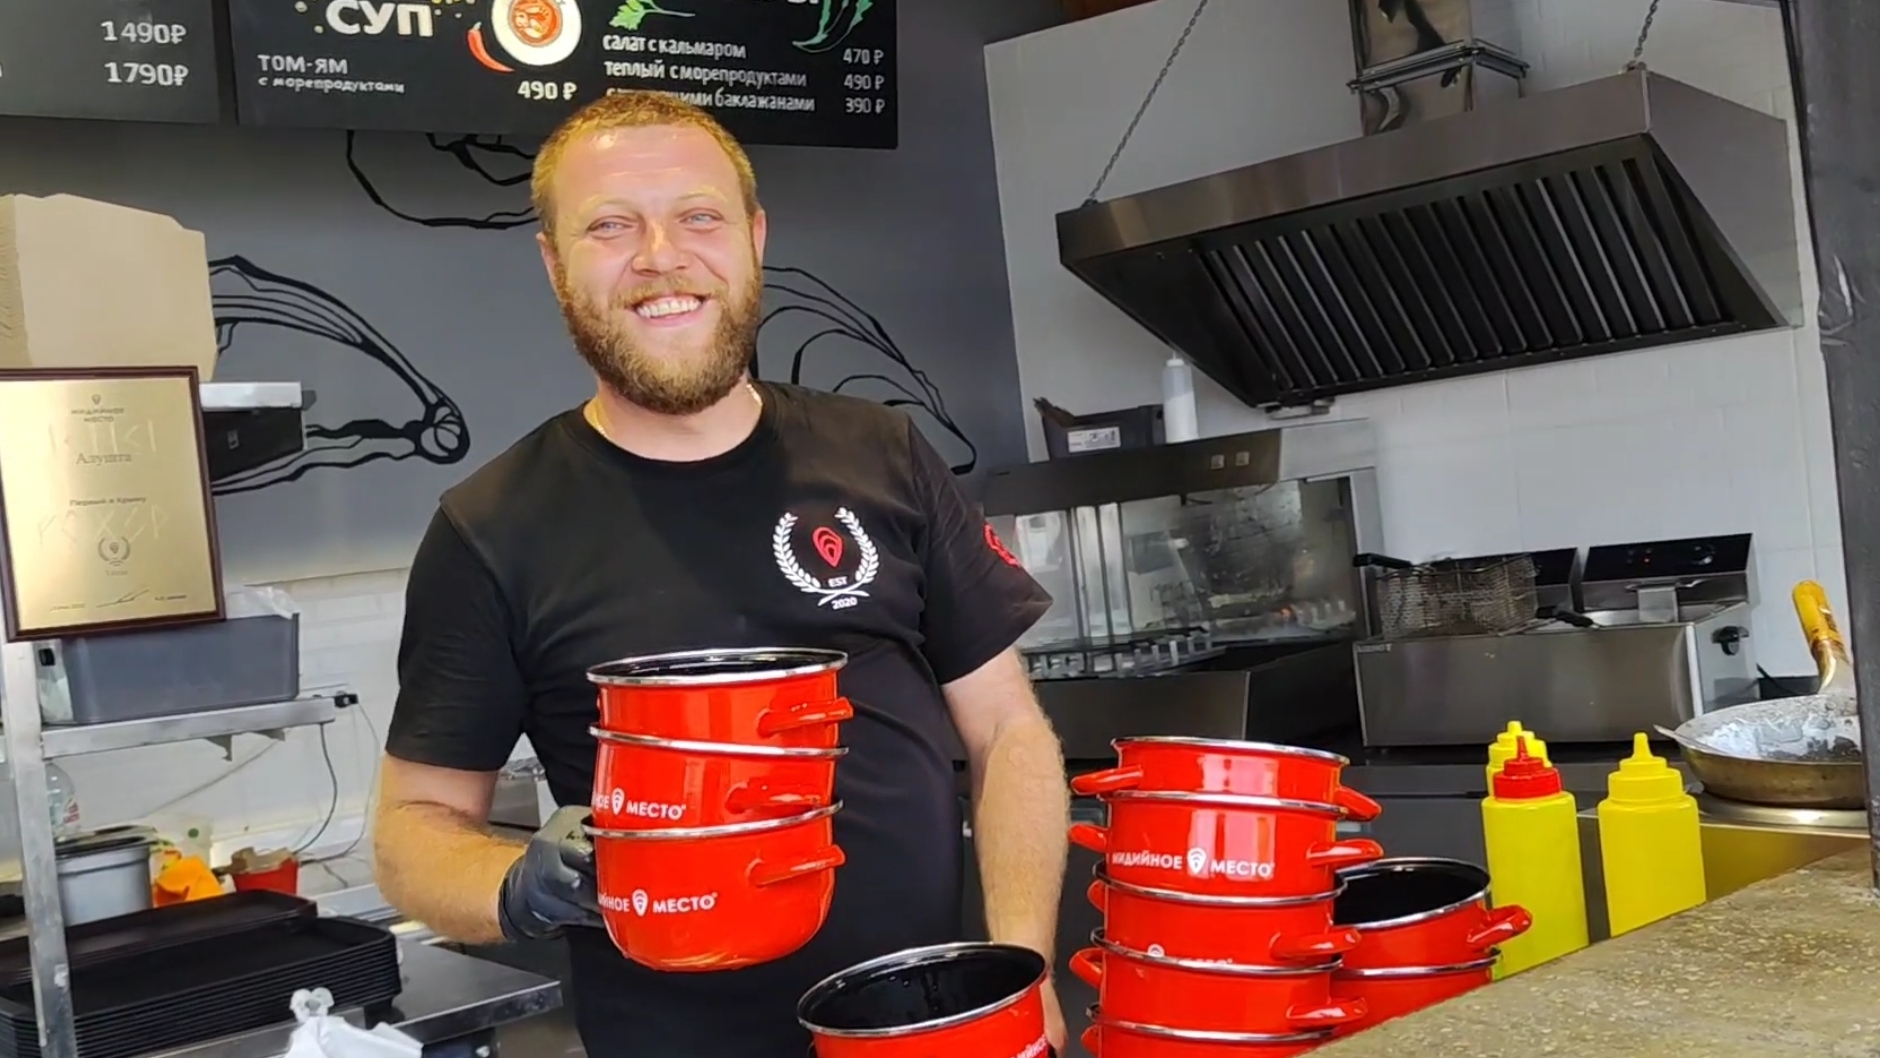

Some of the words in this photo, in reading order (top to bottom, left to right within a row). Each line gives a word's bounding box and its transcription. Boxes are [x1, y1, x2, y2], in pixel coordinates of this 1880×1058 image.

[326, 0, 433, 37] СУП
[602, 34, 646, 52] салат
[648, 38, 657, 51] с
[659, 39, 746, 60] кальмаром
[843, 48, 870, 65] 470
[104, 62, 189, 86] 1790₽
[258, 54, 348, 75] ТОМ-ЯМ
[604, 59, 665, 79] теплый
[670, 65, 679, 79] с
[680, 65, 807, 90] морепродуктами
[258, 76, 269, 86] с
[272, 77, 405, 93] морепродуктами
[517, 80, 558, 100] 490
[843, 74, 872, 90] 490
[715, 87, 815, 112] баклажанами
[845, 97, 872, 113] 390
[828, 576, 848, 587] EST
[831, 596, 857, 610] 2020
